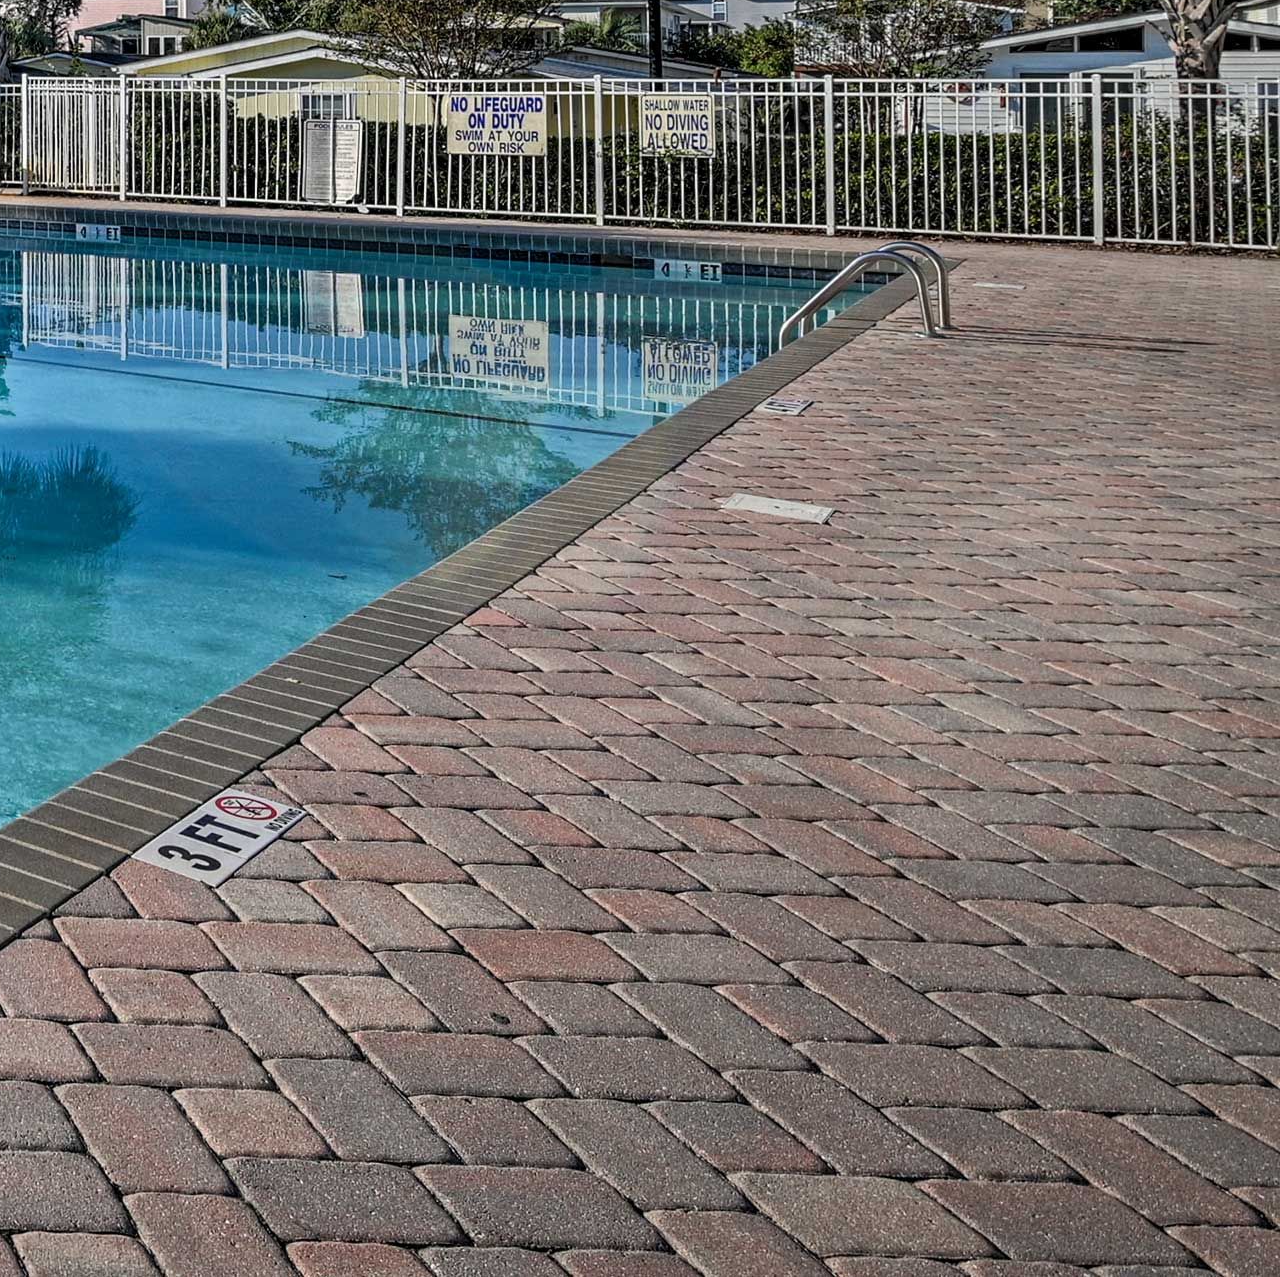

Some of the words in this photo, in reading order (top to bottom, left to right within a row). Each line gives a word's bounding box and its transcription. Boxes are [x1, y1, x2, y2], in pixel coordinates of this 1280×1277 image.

[451, 97, 468, 112] NO
[474, 97, 543, 113] LIFEGUARD
[644, 99, 680, 111] SHALLOW
[683, 100, 709, 111] WATER
[468, 113, 485, 129] ON
[492, 113, 525, 129] DUTY
[645, 113, 663, 130] NO
[667, 113, 709, 131] DIVING
[455, 130, 483, 141] SWIM
[488, 130, 503, 142] AT
[508, 131, 539, 142] YOUR
[647, 132, 708, 150] ALLOWED
[468, 142, 494, 153] OWN
[500, 142, 525, 154] RISK
[273, 808, 302, 824] DIVING
[179, 814, 260, 853] FT
[264, 822, 283, 832] NO
[157, 845, 221, 871] 3
